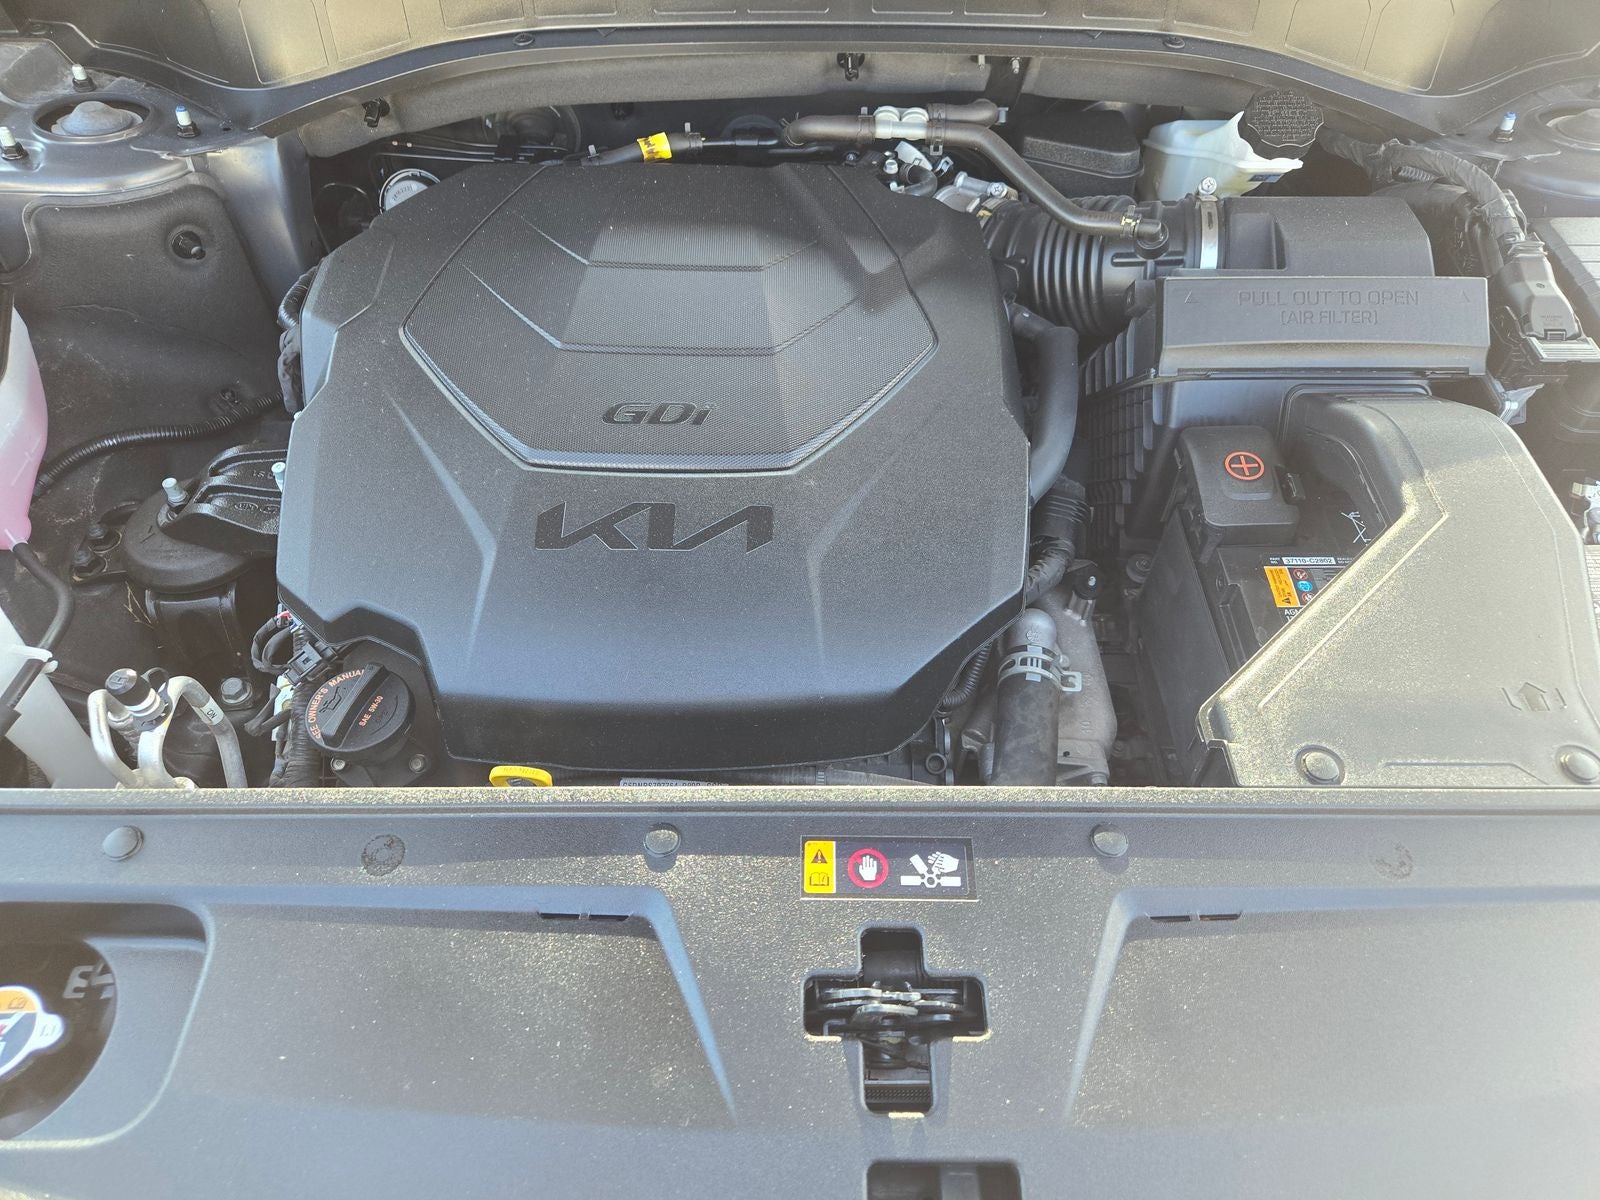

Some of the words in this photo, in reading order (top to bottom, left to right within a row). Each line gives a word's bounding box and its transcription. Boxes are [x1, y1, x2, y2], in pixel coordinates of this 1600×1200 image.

[1238, 290, 1289, 307] PULL
[1293, 290, 1333, 307] OUT
[1337, 290, 1362, 306] TO
[1367, 290, 1419, 306] OPEN
[602, 402, 713, 426] GDi
[308, 687, 329, 723] OWNER'S
[358, 713, 372, 727] SAE
